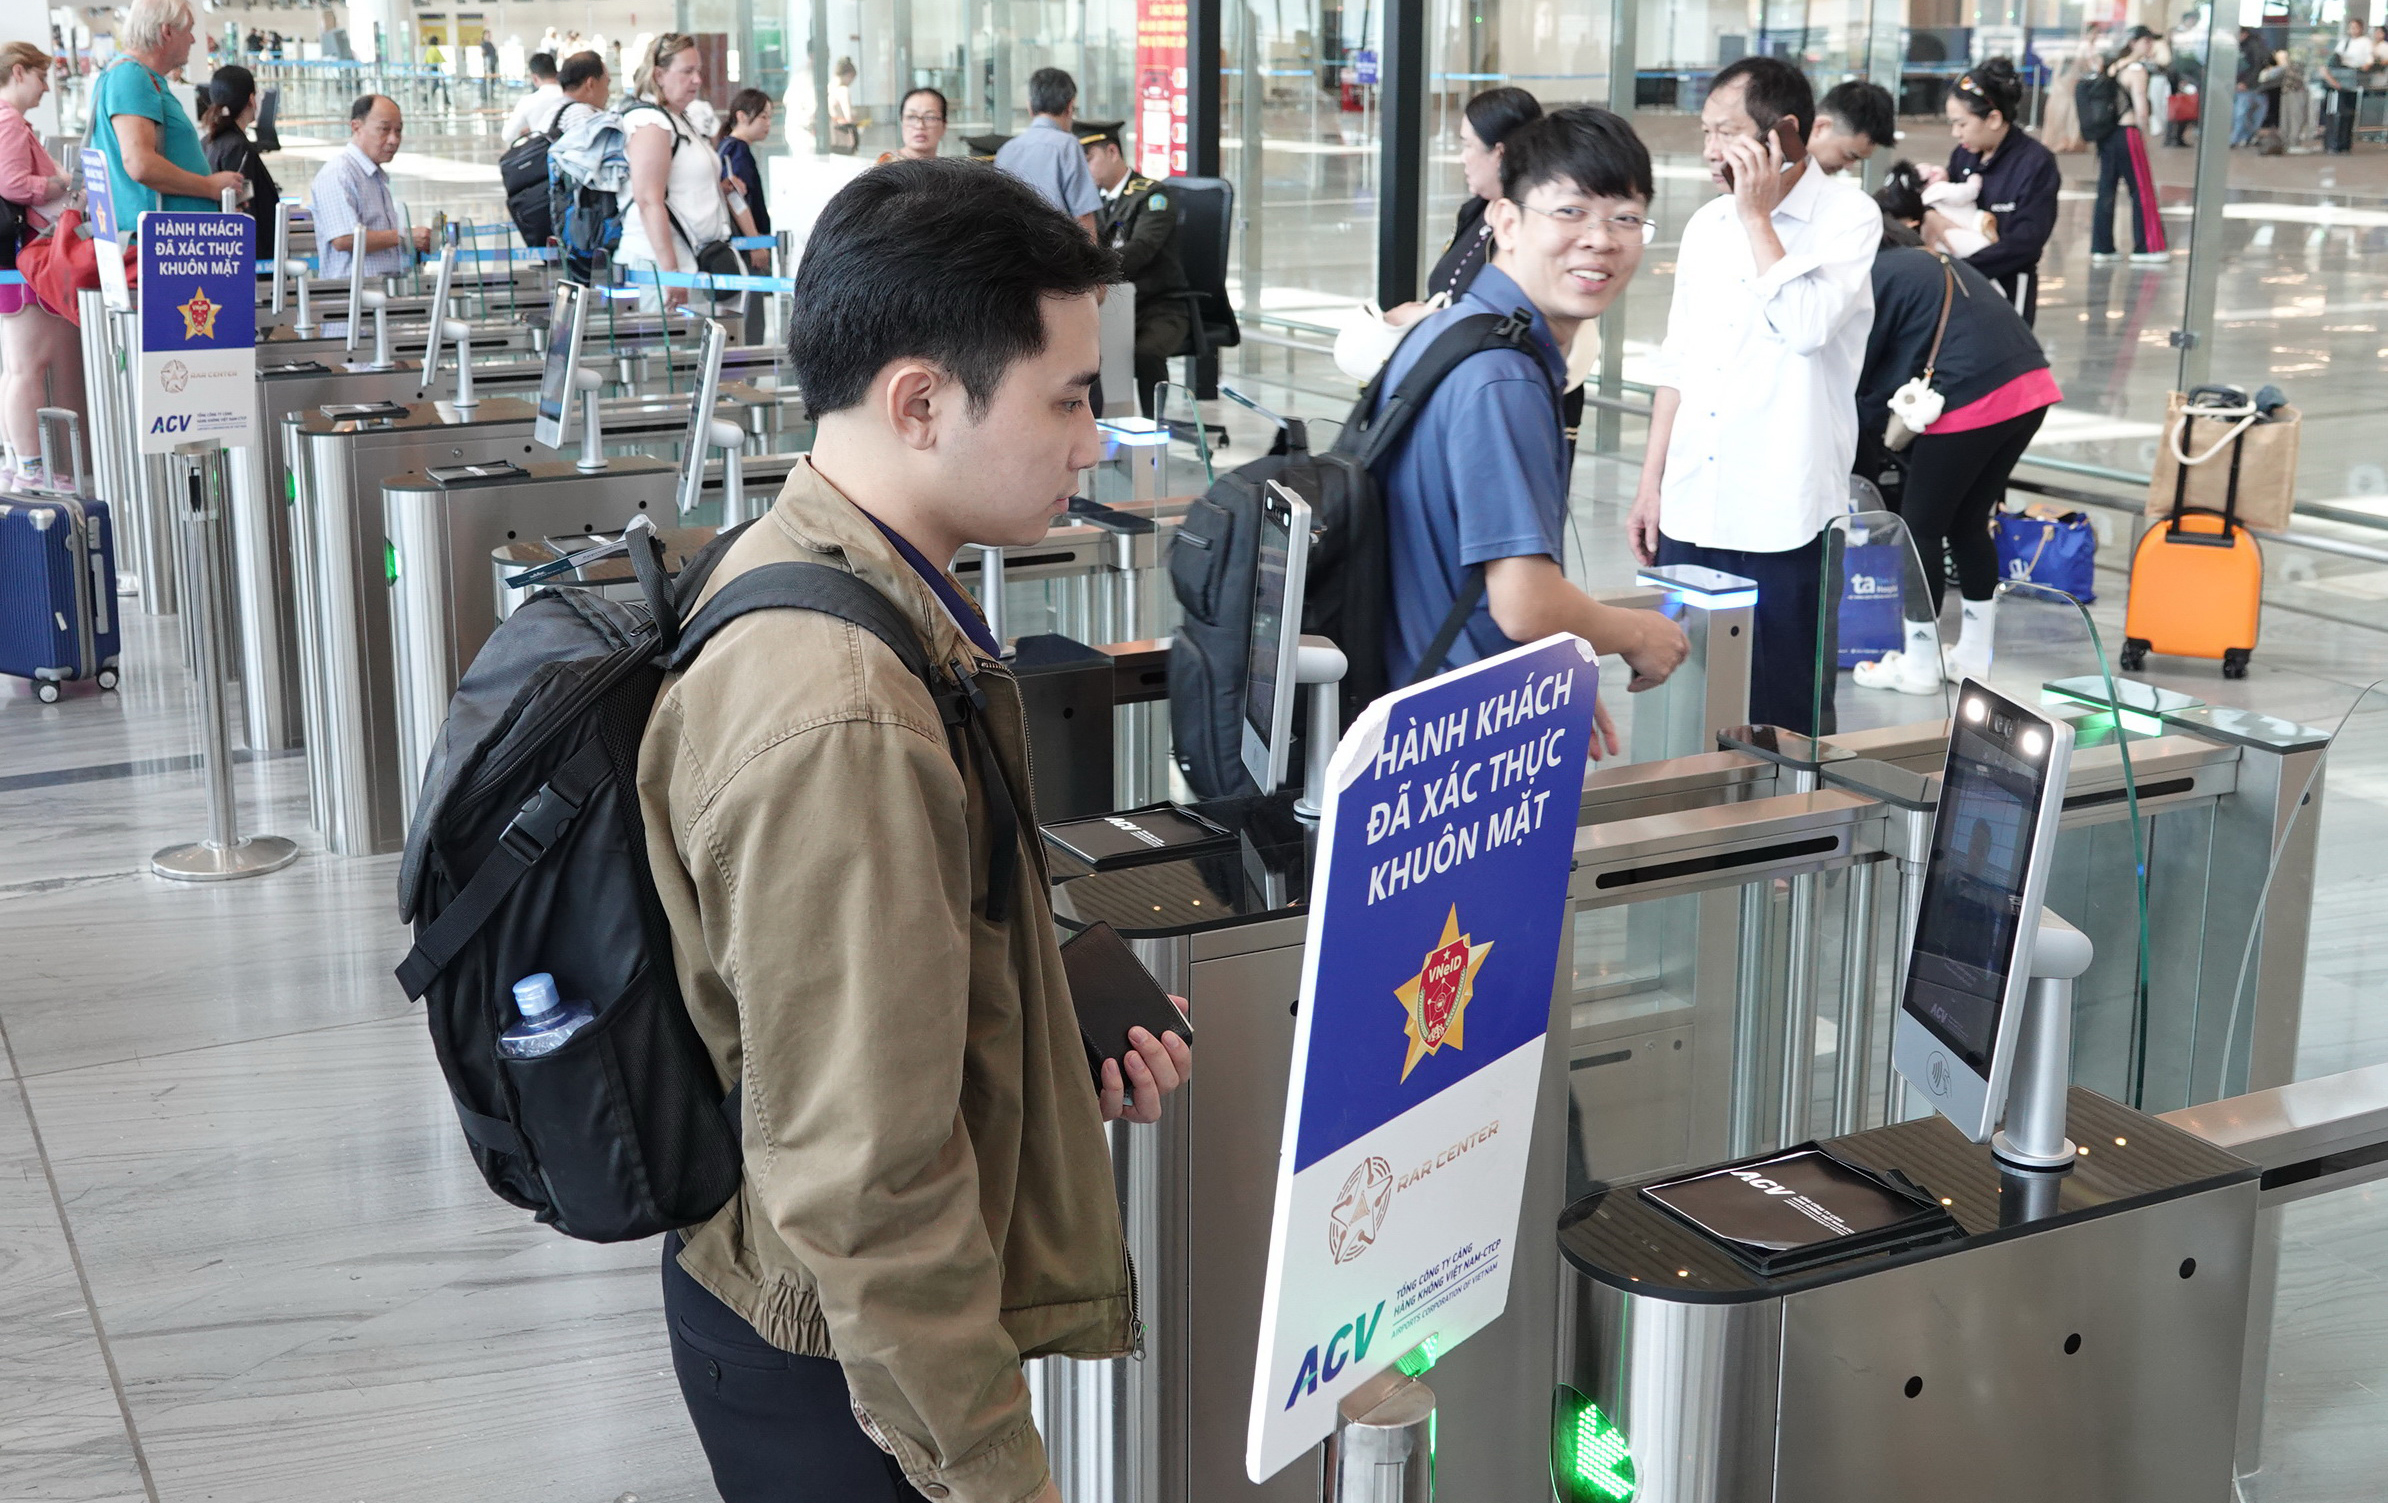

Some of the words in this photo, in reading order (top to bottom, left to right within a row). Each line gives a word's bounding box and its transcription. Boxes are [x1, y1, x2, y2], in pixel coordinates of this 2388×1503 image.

[155, 219, 196, 236] HÀNH
[199, 219, 243, 236] KHÁCH
[155, 239, 175, 256] ĐÃ
[178, 239, 205, 256] XÁC
[207, 241, 243, 258] THỰC
[160, 258, 207, 275] KHUÔN
[211, 259, 240, 277] MẶT
[150, 414, 192, 434] ACV
[1850, 573, 1876, 594] ta
[1374, 708, 1468, 780] HÀNH
[1475, 668, 1574, 740] KHÁCH
[1366, 780, 1411, 845] ĐÃ
[1419, 760, 1481, 823] XÁC
[1489, 728, 1565, 792] THỰC
[1367, 823, 1479, 906] KHUÔN
[1486, 789, 1550, 851] MẶT
[1429, 955, 1462, 983] VNeID
[1397, 1160, 1432, 1193] RAR
[1436, 1120, 1499, 1168] CENTER
[1730, 1171, 1796, 1195] ACV
[1393, 1296, 1416, 1317] HÀNG
[1417, 1277, 1444, 1301] KHÔNG
[1446, 1264, 1462, 1281] VIỆT
[1396, 1279, 1417, 1300] TỔNG
[1419, 1265, 1440, 1285] CÔNG
[1442, 1257, 1451, 1270] TY
[1452, 1242, 1473, 1263] CẢNG
[1391, 1312, 1421, 1339] AIRPORTS
[1421, 1285, 1462, 1318] CORPORATION
[1463, 1280, 1471, 1290] OF
[1284, 1299, 1386, 1412] ACV
